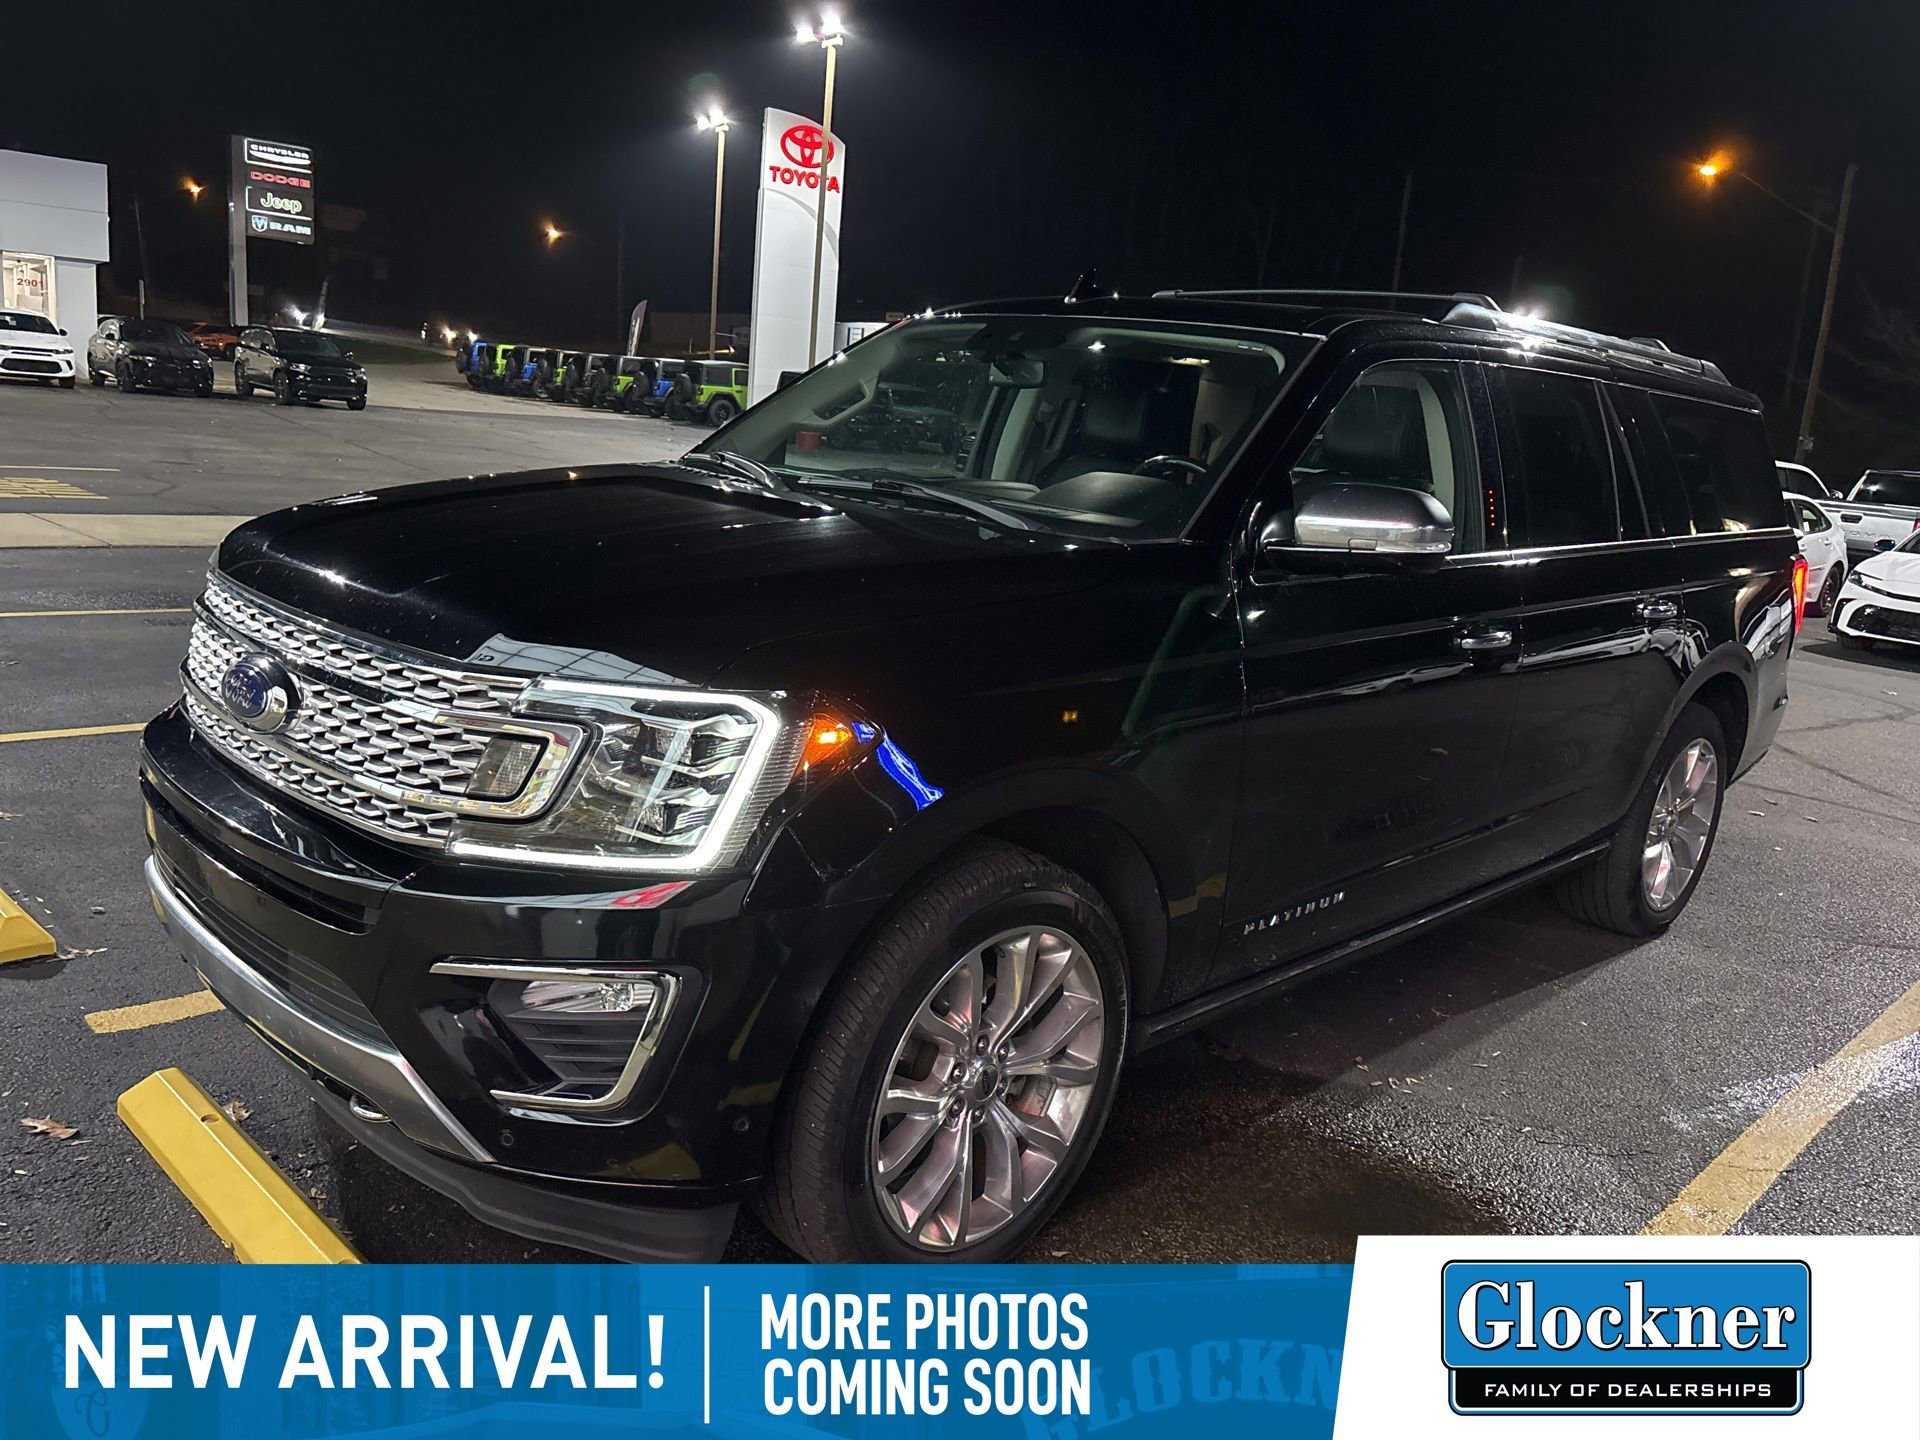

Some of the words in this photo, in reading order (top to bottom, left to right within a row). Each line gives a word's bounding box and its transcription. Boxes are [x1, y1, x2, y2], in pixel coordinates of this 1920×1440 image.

[250, 144, 309, 159] CHRYSLER
[250, 171, 311, 188] DODGE
[769, 165, 840, 193] TOYOA
[260, 192, 302, 214] Jeep
[269, 222, 311, 235] RAM
[17, 278, 44, 288] 2901
[1243, 891, 1346, 936] PLATINUM
